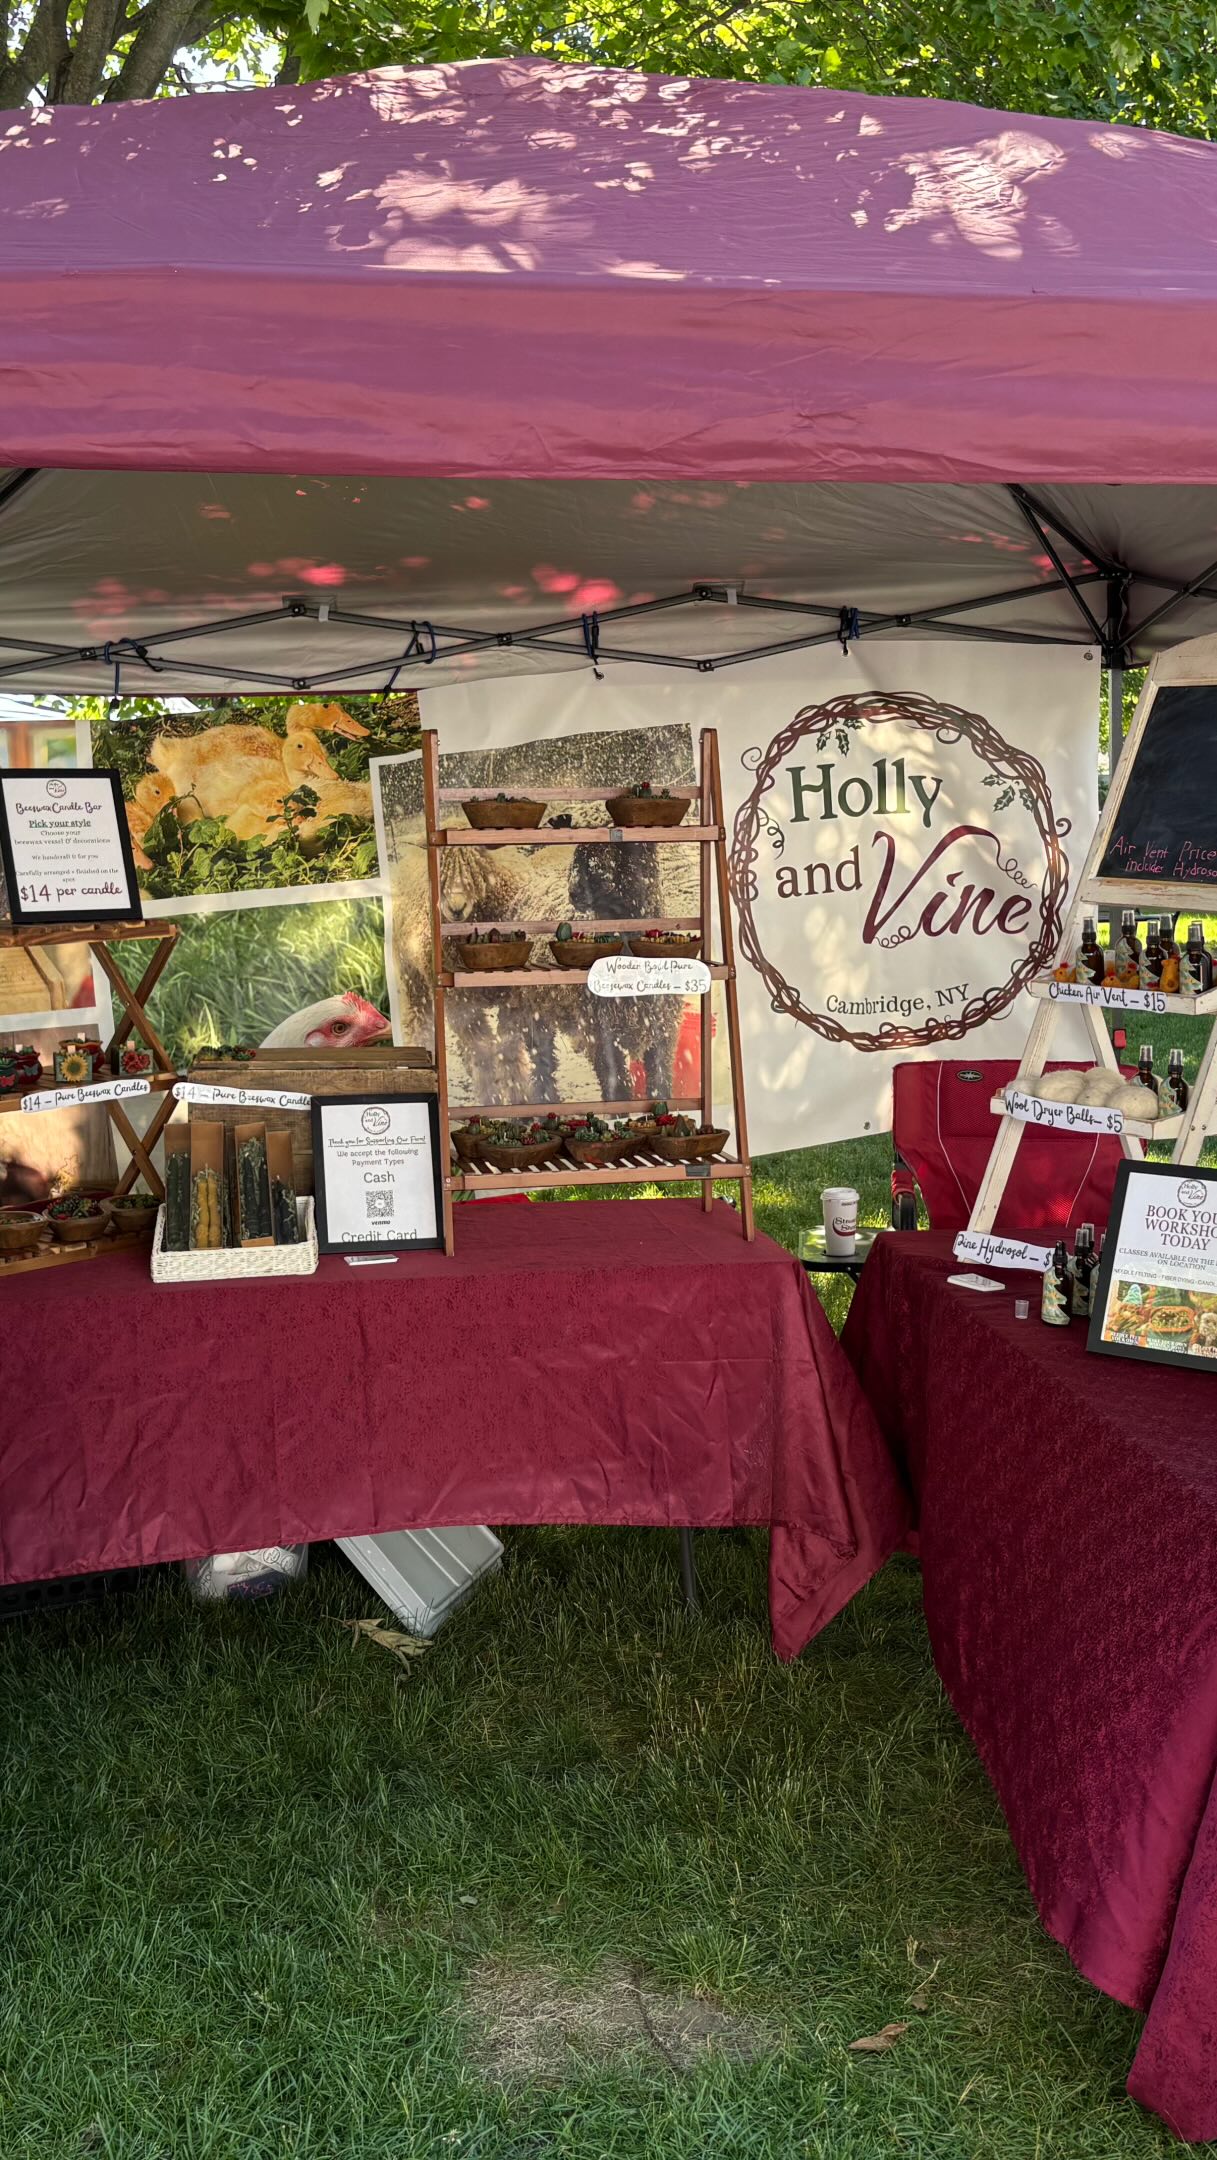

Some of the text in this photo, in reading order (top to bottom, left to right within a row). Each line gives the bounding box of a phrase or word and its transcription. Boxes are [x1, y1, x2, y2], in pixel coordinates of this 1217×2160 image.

[785, 757, 943, 828] Holly
[52, 801, 84, 813] Candle
[85, 801, 102, 813] Bar
[29, 819, 91, 829] Pick your style
[1109, 835, 1137, 856] Air
[1144, 840, 1169, 859] Vent
[20, 881, 123, 903] $14 per candle
[775, 825, 1035, 946] and Vine
[606, 957, 640, 974] Wooden
[670, 960, 694, 974] Pure
[637, 980, 671, 993] Candles
[685, 980, 707, 993] $35
[826, 983, 969, 1017] Cambridge, NY
[1048, 982, 1084, 1000] Chicken
[1085, 986, 1100, 1005] Air
[1101, 987, 1128, 1007] Vent
[1143, 991, 1166, 1012] $15
[23, 1095, 41, 1111] $14
[55, 1092, 75, 1106] Pure
[77, 1088, 111, 1102] Beeswax
[114, 1082, 148, 1096] Candles
[175, 1086, 195, 1099] $14
[212, 1088, 236, 1101] Pure
[1005, 1091, 1029, 1114] Wool
[1032, 1100, 1063, 1126] Dryer
[1106, 1114, 1122, 1133] $5
[328, 1138, 344, 1146] Thank
[345, 1139, 356, 1148] you
[365, 1136, 395, 1145] Supporting
[350, 1150, 373, 1158] accept
[388, 1148, 419, 1157] following
[352, 1158, 404, 1167] Payment Types
[363, 1171, 395, 1183] Cash
[1146, 1204, 1188, 1222] BOOK
[341, 1229, 418, 1243] Credit Card
[1160, 1233, 1210, 1251] TODAY
[958, 1233, 977, 1250] Pine
[977, 1238, 1029, 1264] Hydrosol
[1119, 1247, 1216, 1266] CLASSES AVAILABLE ON THE
[1169, 1260, 1206, 1271] LOCATION
